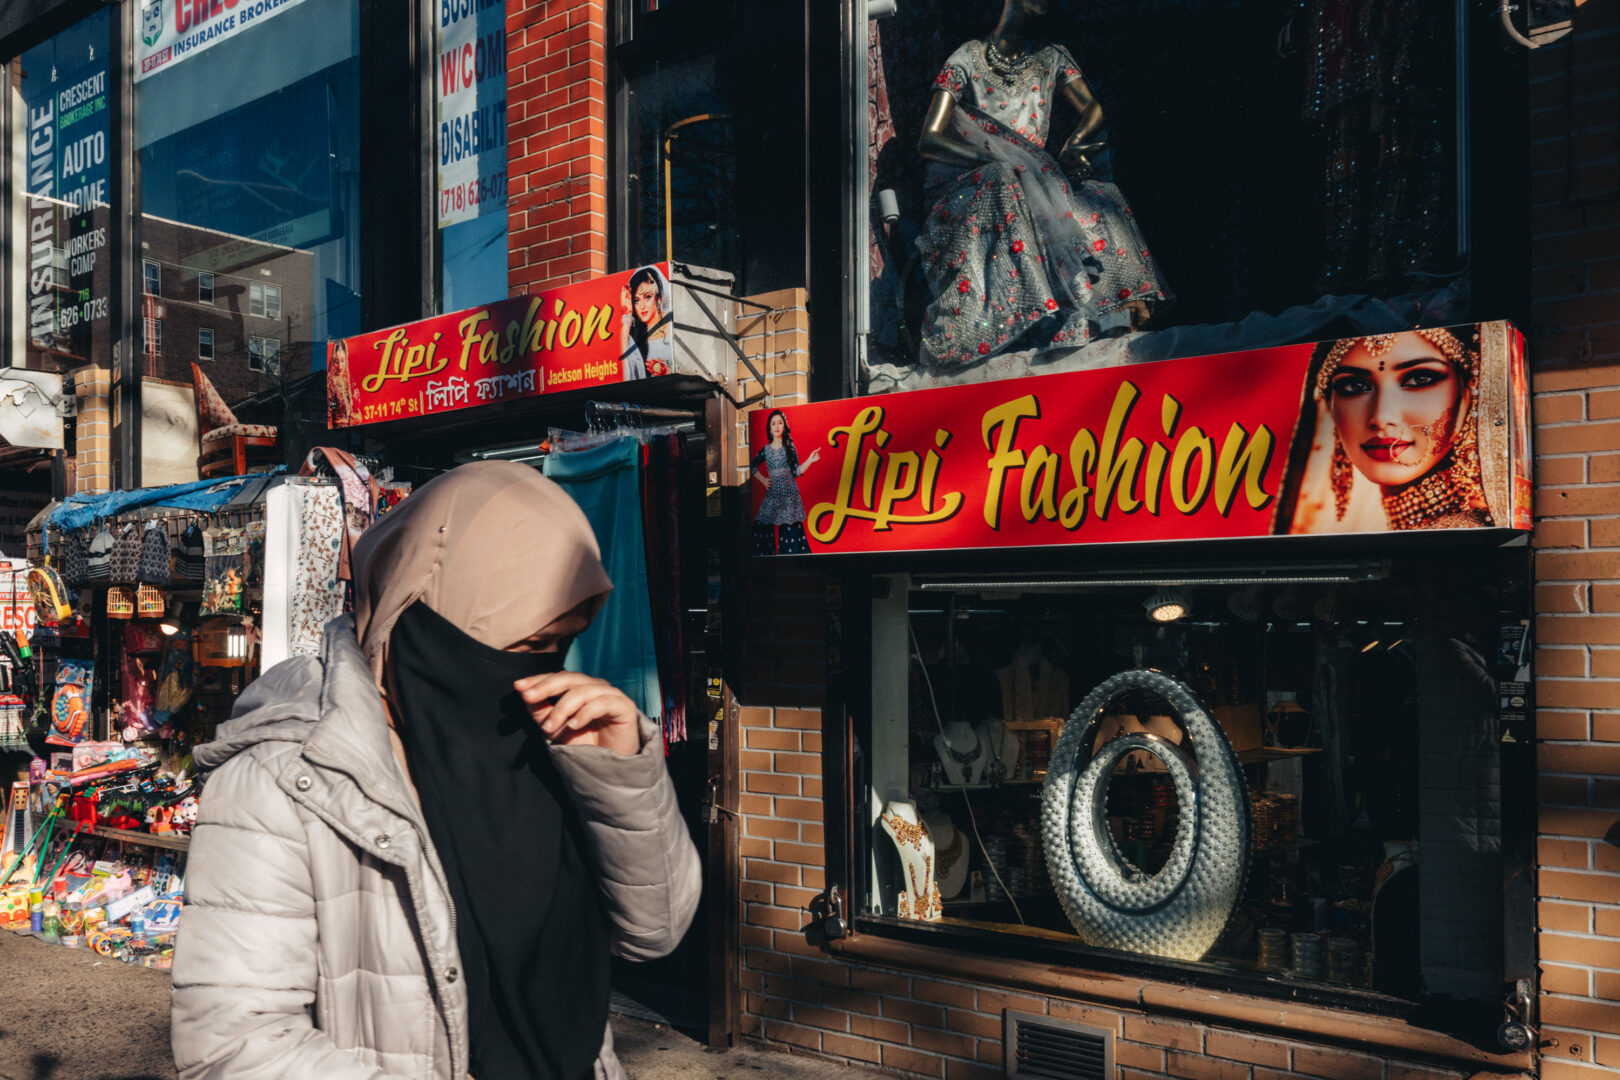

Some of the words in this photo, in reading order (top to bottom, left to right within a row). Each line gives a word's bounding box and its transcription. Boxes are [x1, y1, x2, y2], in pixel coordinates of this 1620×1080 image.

[174, 15, 235, 56] INSURANCE
[60, 70, 106, 112] CRESCENT
[60, 99, 94, 130] BROKERAGE
[63, 130, 105, 179] AUTO
[31, 99, 54, 338] INSURANCE
[63, 178, 105, 221] HOME
[440, 182, 466, 218] (718)
[64, 227, 106, 259] WORKERS
[71, 252, 96, 277] COMP
[78, 288, 90, 302] 718
[362, 328, 449, 393] Lipi
[459, 297, 613, 371] Fashion
[547, 369, 583, 386] Jackson
[584, 359, 618, 380] Heights
[364, 403, 388, 420] 37-11
[408, 398, 418, 412] St
[806, 405, 962, 543] Lipi
[981, 381, 1271, 530] Fashion
